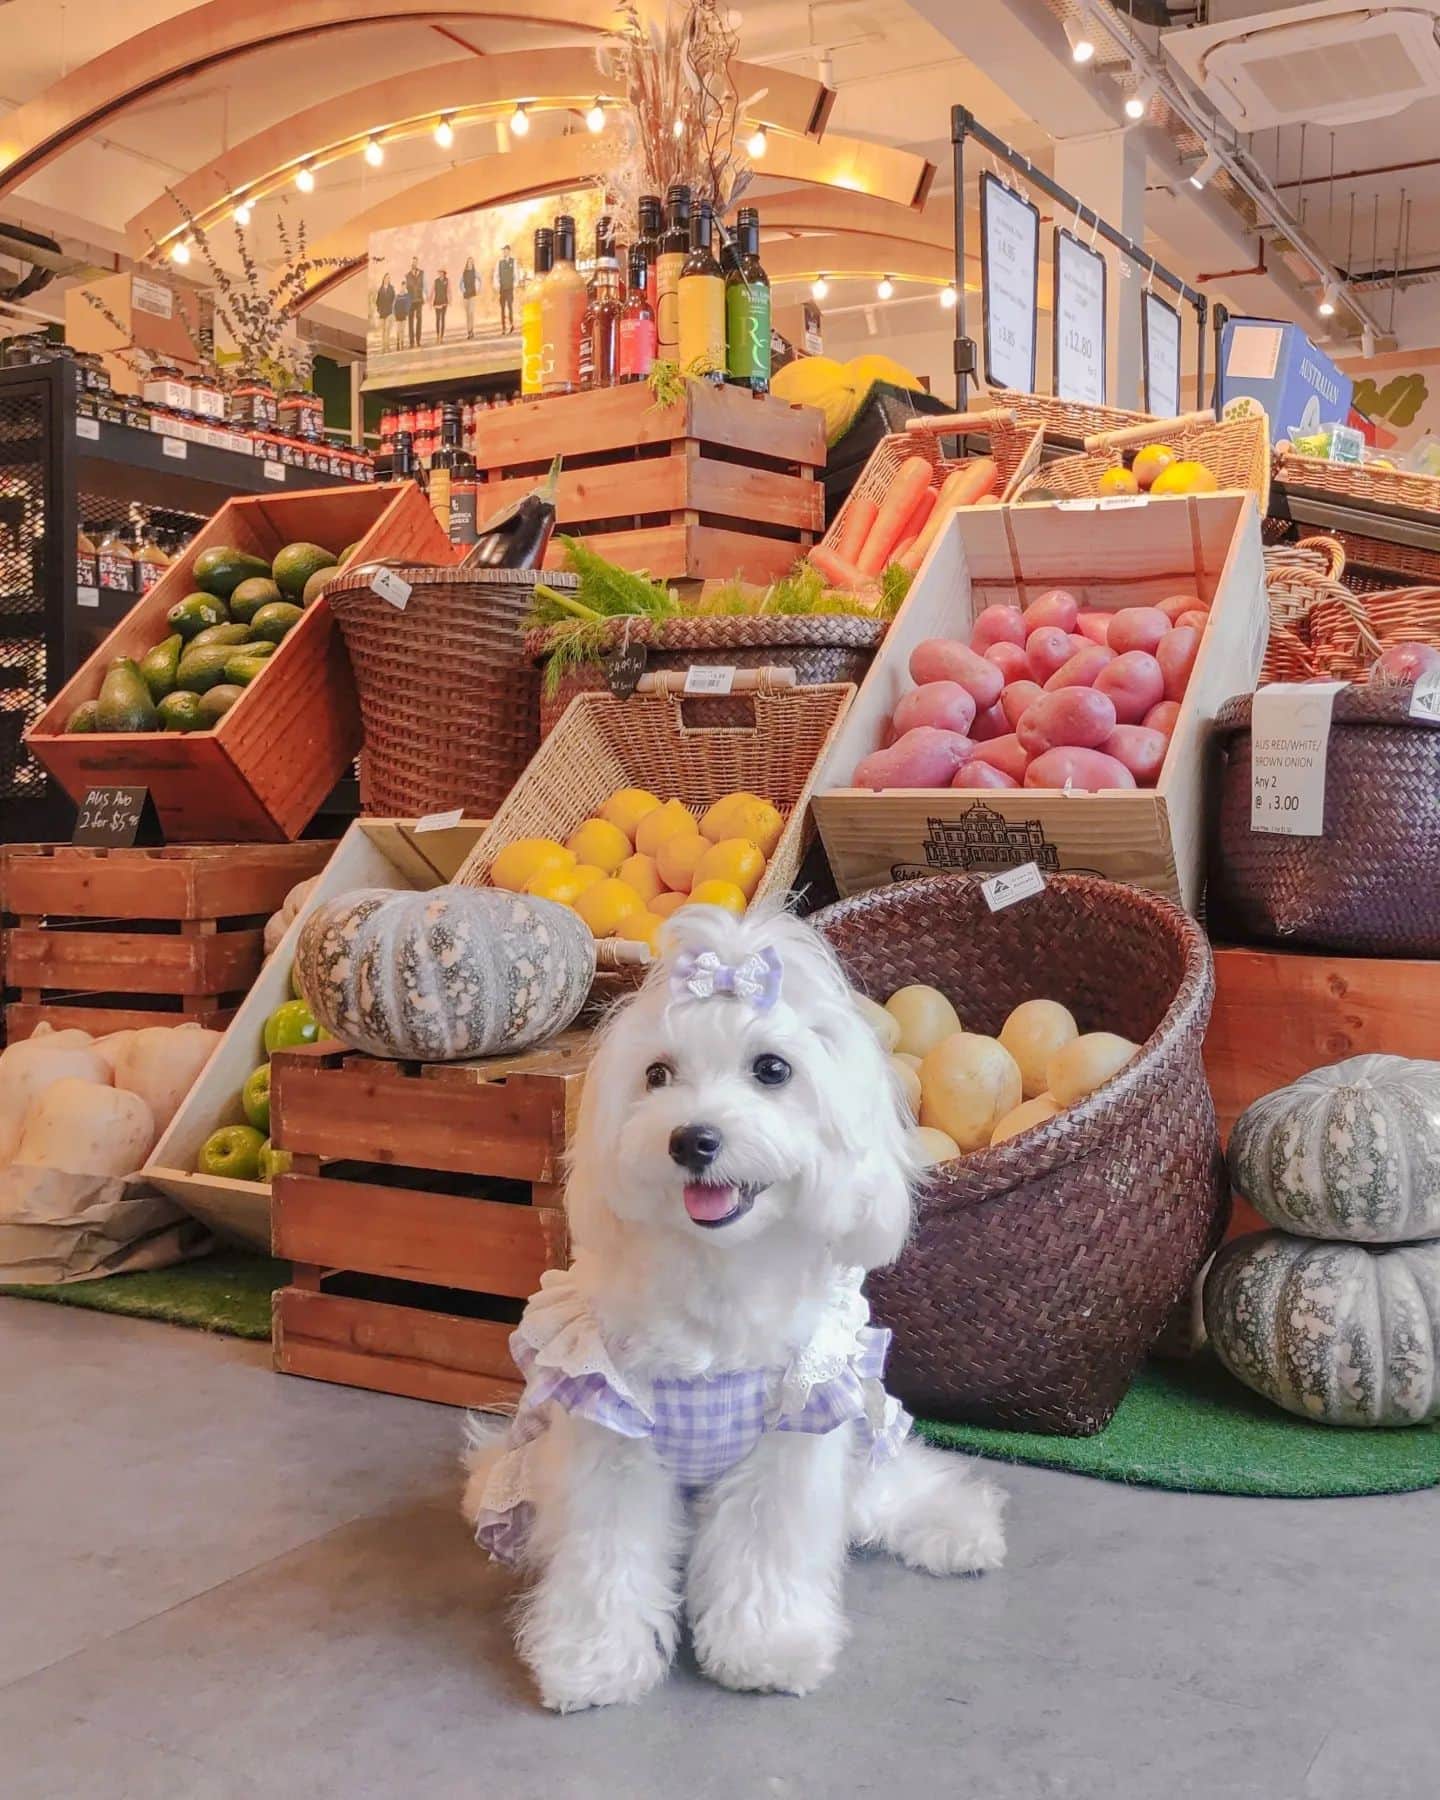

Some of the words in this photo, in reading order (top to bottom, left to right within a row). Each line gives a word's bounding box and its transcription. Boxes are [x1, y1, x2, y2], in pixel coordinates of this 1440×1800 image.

[1299, 357, 1340, 405] AUSTRALIAN
[1285, 757, 1313, 767] ONION
[1255, 776, 1270, 790] Any
[1271, 776, 1278, 788] 2
[79, 811, 90, 829] 2
[91, 811, 109, 828] for
